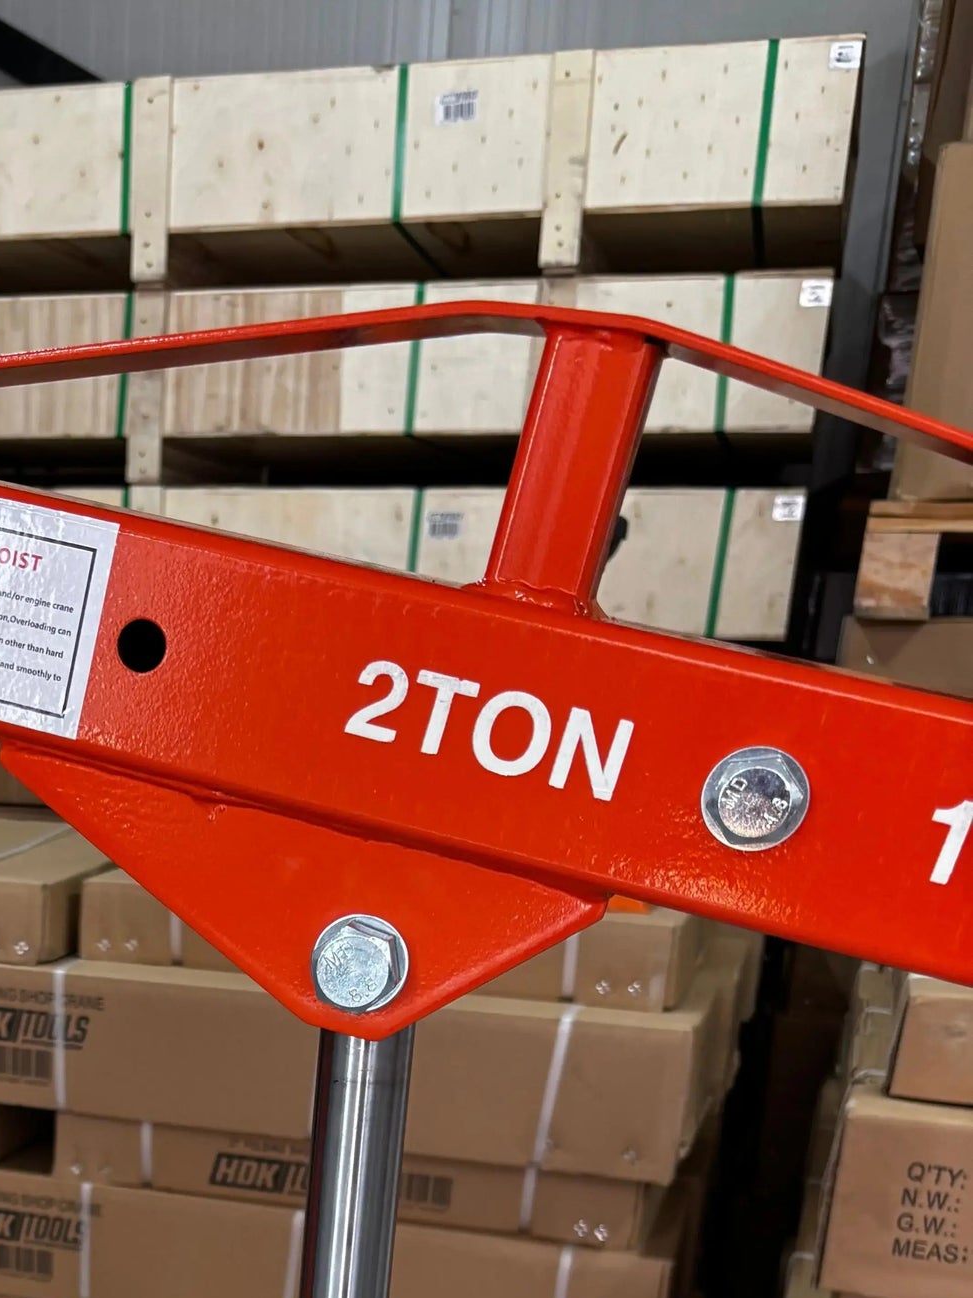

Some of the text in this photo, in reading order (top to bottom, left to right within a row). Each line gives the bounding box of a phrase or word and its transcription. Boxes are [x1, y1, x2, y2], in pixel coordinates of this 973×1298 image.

[24, 596, 51, 607] engine
[52, 602, 74, 613] crane
[57, 627, 71, 636] can
[4, 638, 25, 649] other
[26, 642, 44, 653] than
[45, 647, 63, 658] hard
[0, 660, 14, 669] and
[16, 664, 52, 680] smoothly
[52, 672, 61, 681] to
[344, 660, 634, 802] 2TON
[216, 1157, 280, 1189] HDK
[907, 1161, 967, 1190] Q'TY:
[901, 1187, 961, 1213] N.W.:
[897, 1212, 957, 1238] G.W.:
[892, 1237, 968, 1264] MEAS:
